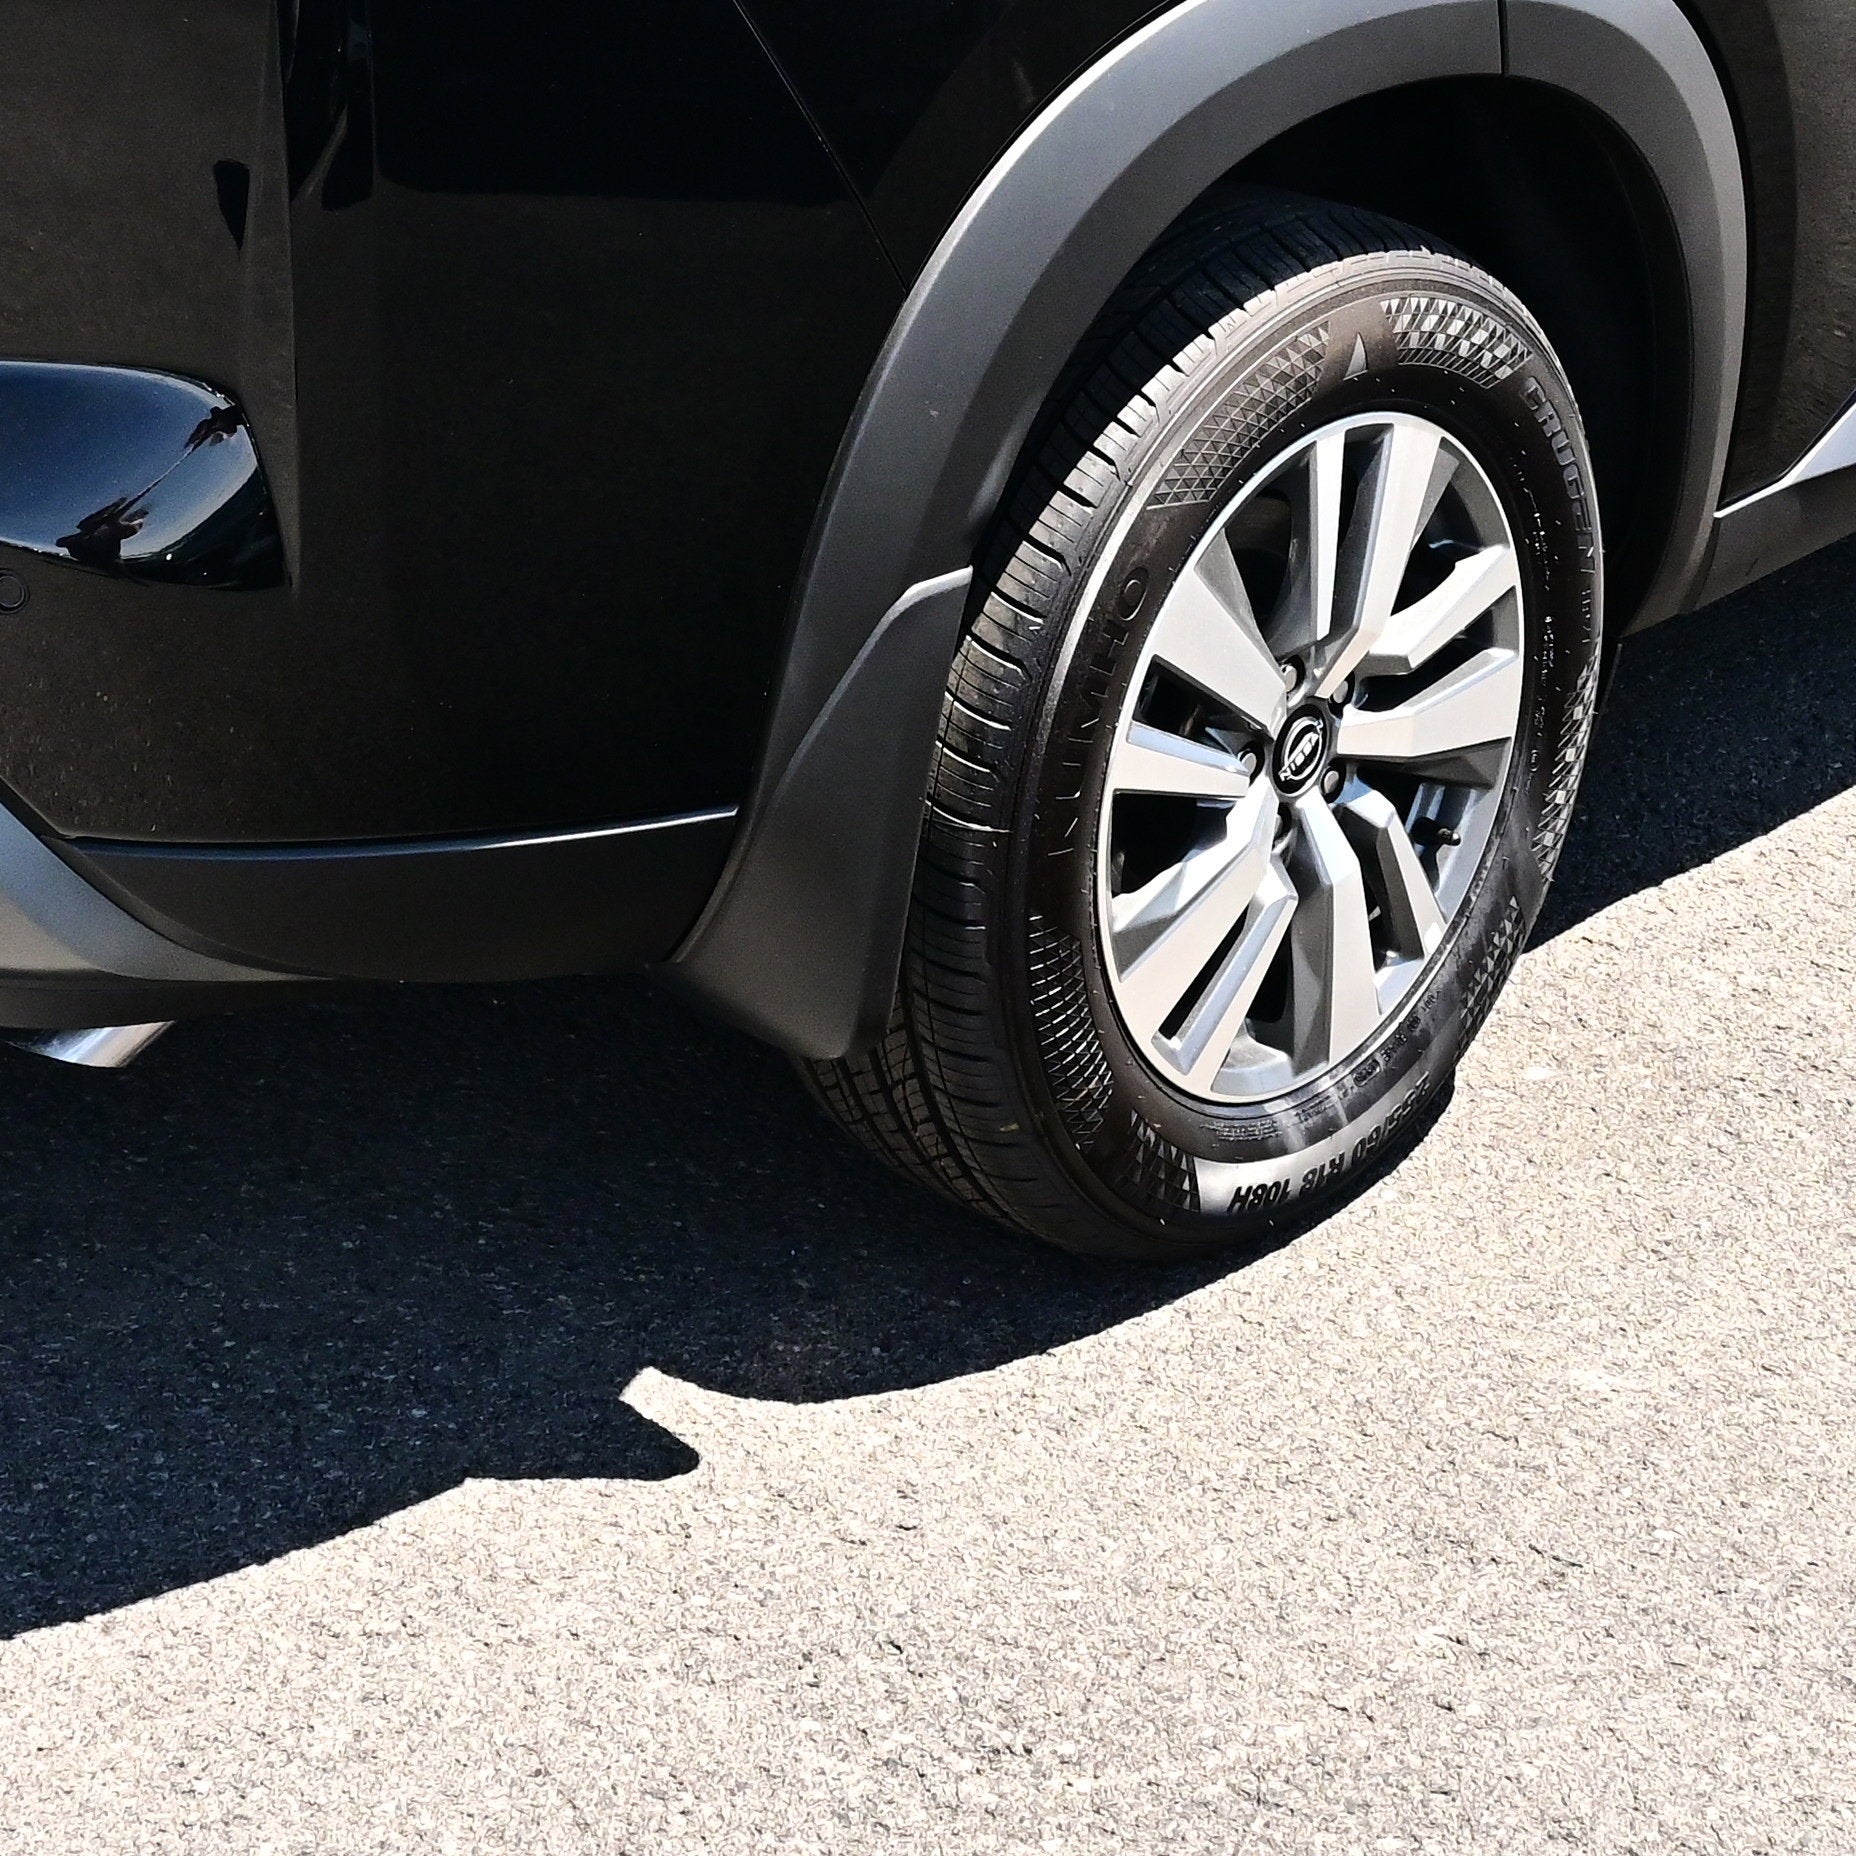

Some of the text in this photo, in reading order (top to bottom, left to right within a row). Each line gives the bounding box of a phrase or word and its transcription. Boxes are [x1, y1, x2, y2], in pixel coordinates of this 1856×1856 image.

[1350, 1070, 1431, 1168] 255/60
[1298, 1151, 1346, 1195] R18
[1226, 1177, 1292, 1214] 108H
